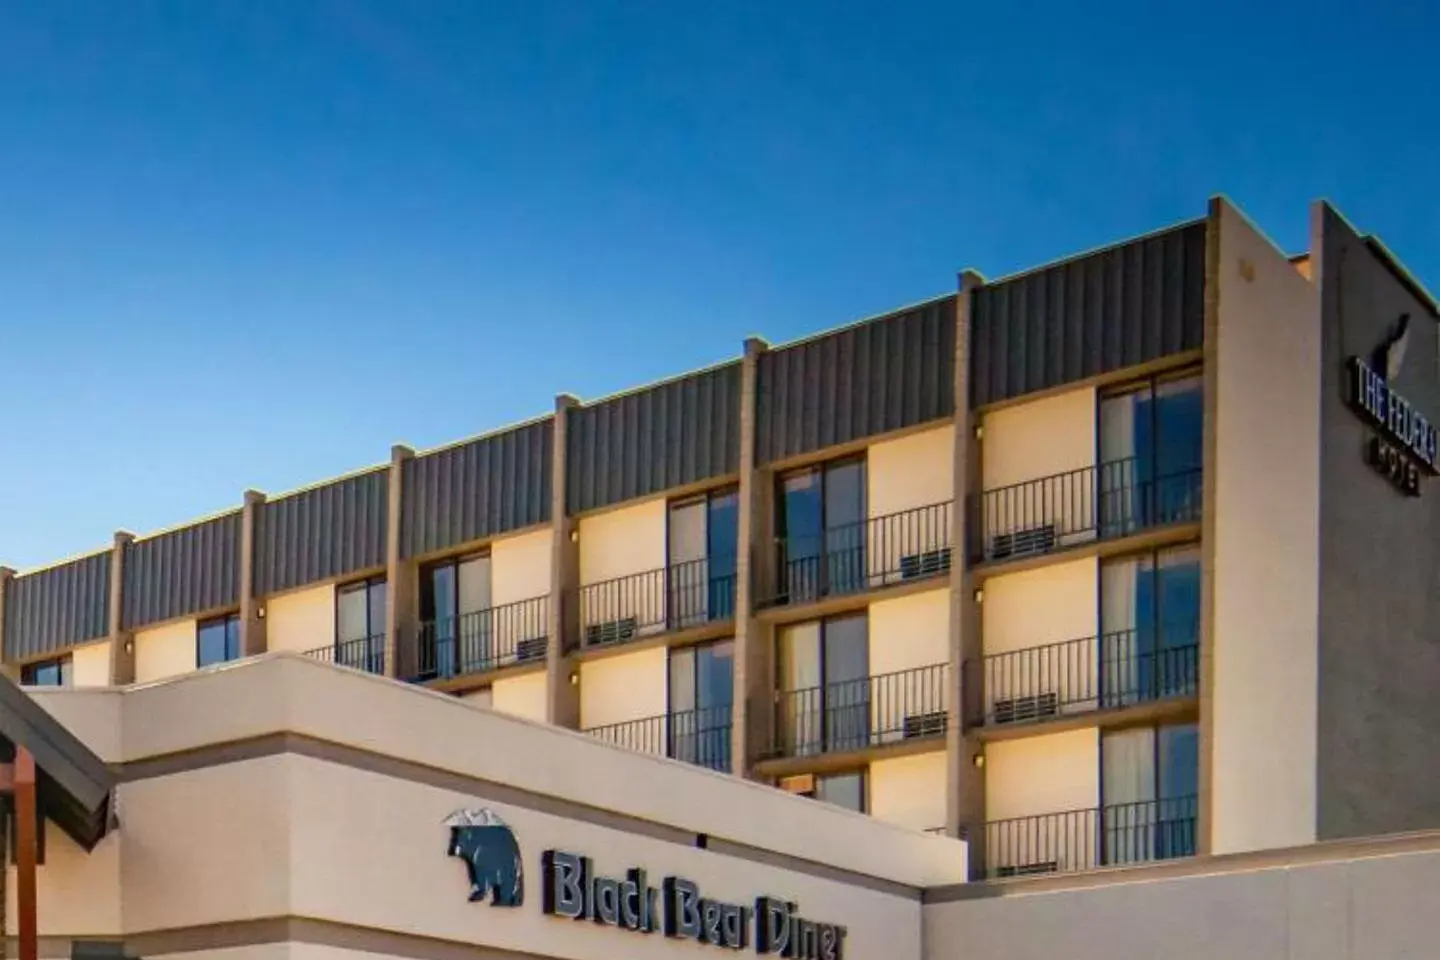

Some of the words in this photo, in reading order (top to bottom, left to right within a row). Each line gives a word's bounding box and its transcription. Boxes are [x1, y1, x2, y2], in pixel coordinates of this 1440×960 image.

[1349, 355, 1386, 424] THE
[542, 849, 659, 933] Black
[663, 876, 752, 949] Bear
